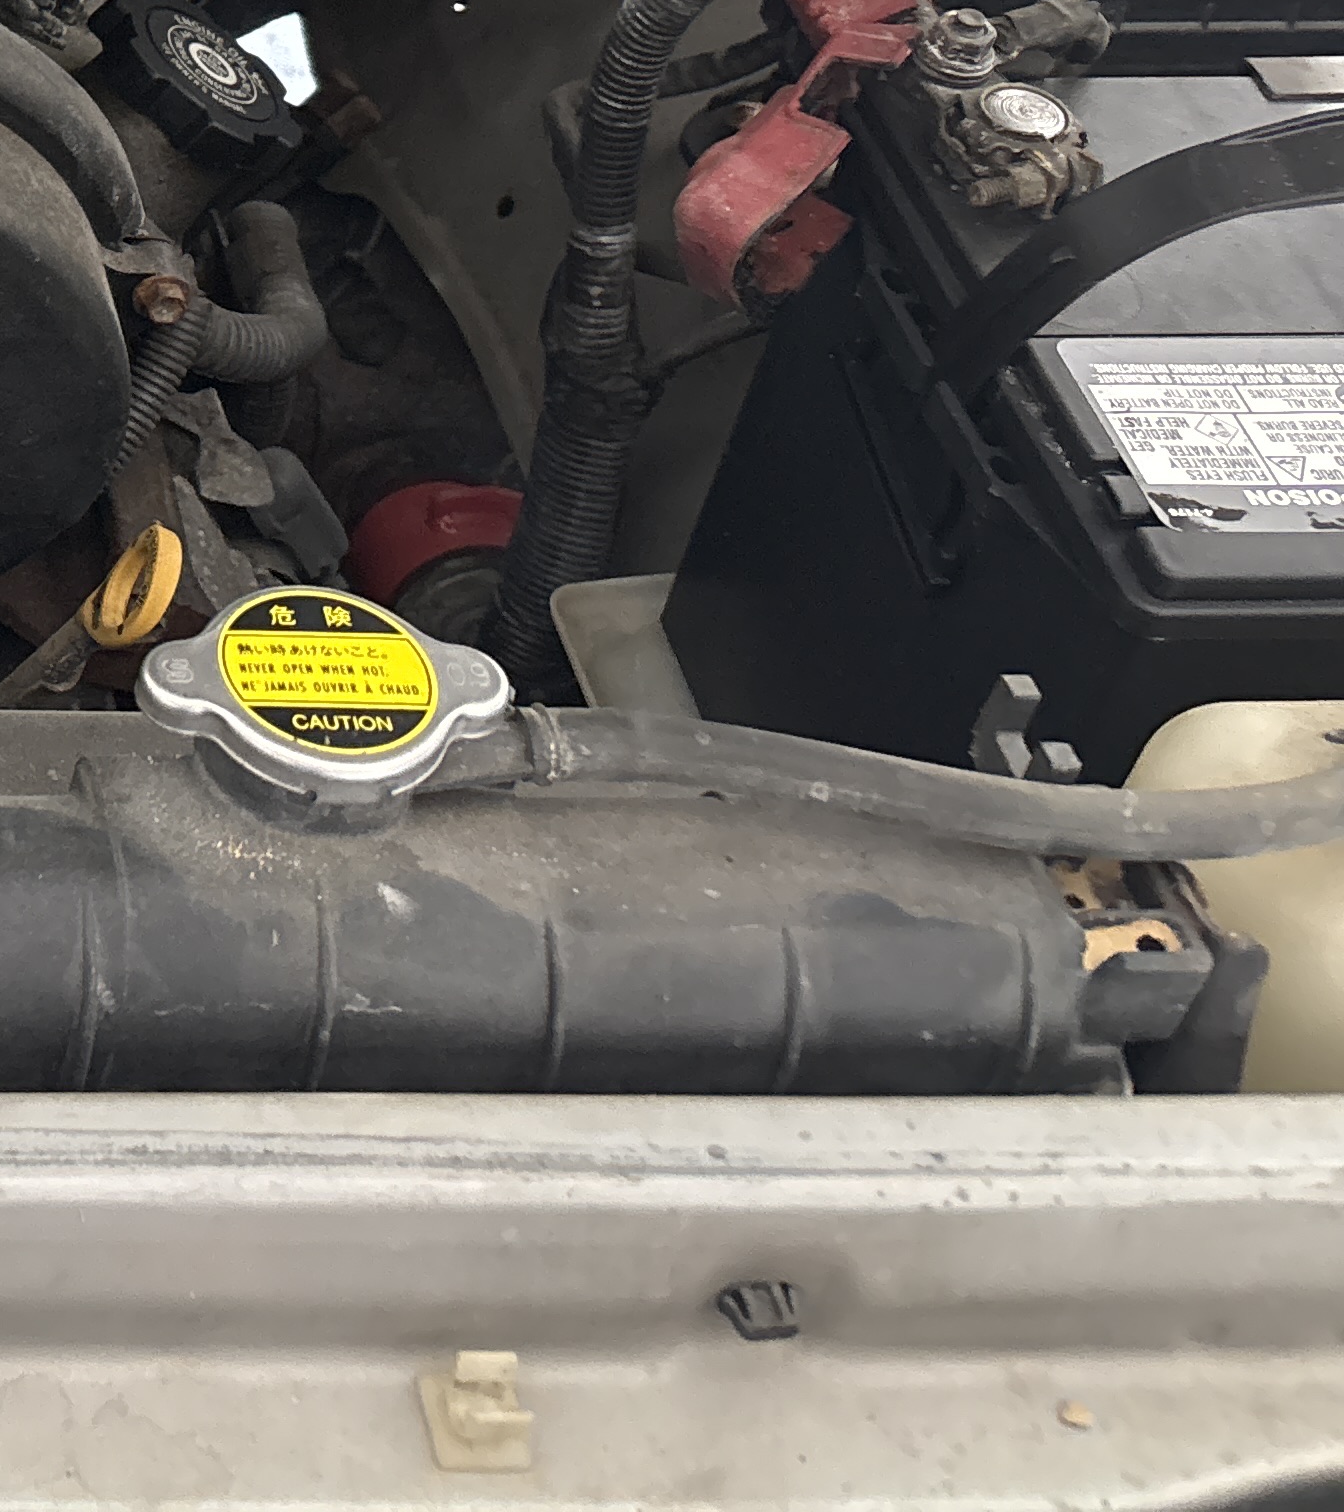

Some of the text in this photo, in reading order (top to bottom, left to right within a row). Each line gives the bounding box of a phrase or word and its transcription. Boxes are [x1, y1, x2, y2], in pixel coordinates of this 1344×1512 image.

[1190, 389, 1212, 399] NOT
[1214, 389, 1233, 399] DO
[1162, 398, 1194, 409] OPEN
[1197, 399, 1219, 409] NOT
[1221, 399, 1241, 409] DO
[1281, 398, 1340, 409] READ ALL
[1155, 416, 1191, 428] HELP
[1298, 420, 1344, 431] SEVERE
[1118, 428, 1184, 441] MEDICAL
[1265, 432, 1286, 443] OR
[1129, 441, 1156, 453] GET
[1215, 445, 1254, 457] WITH
[1293, 444, 1334, 455] CAUSE
[1168, 457, 1261, 469] IMMEDIATELY
[1185, 469, 1269, 482] FLUSH EYES
[239, 662, 276, 674] NEVER
[282, 663, 314, 675] OPEN
[320, 664, 356, 676] WHEN
[264, 680, 307, 693] JAMAIS
[313, 681, 359, 694] OUVRIR
[291, 713, 394, 733] CAUTION
